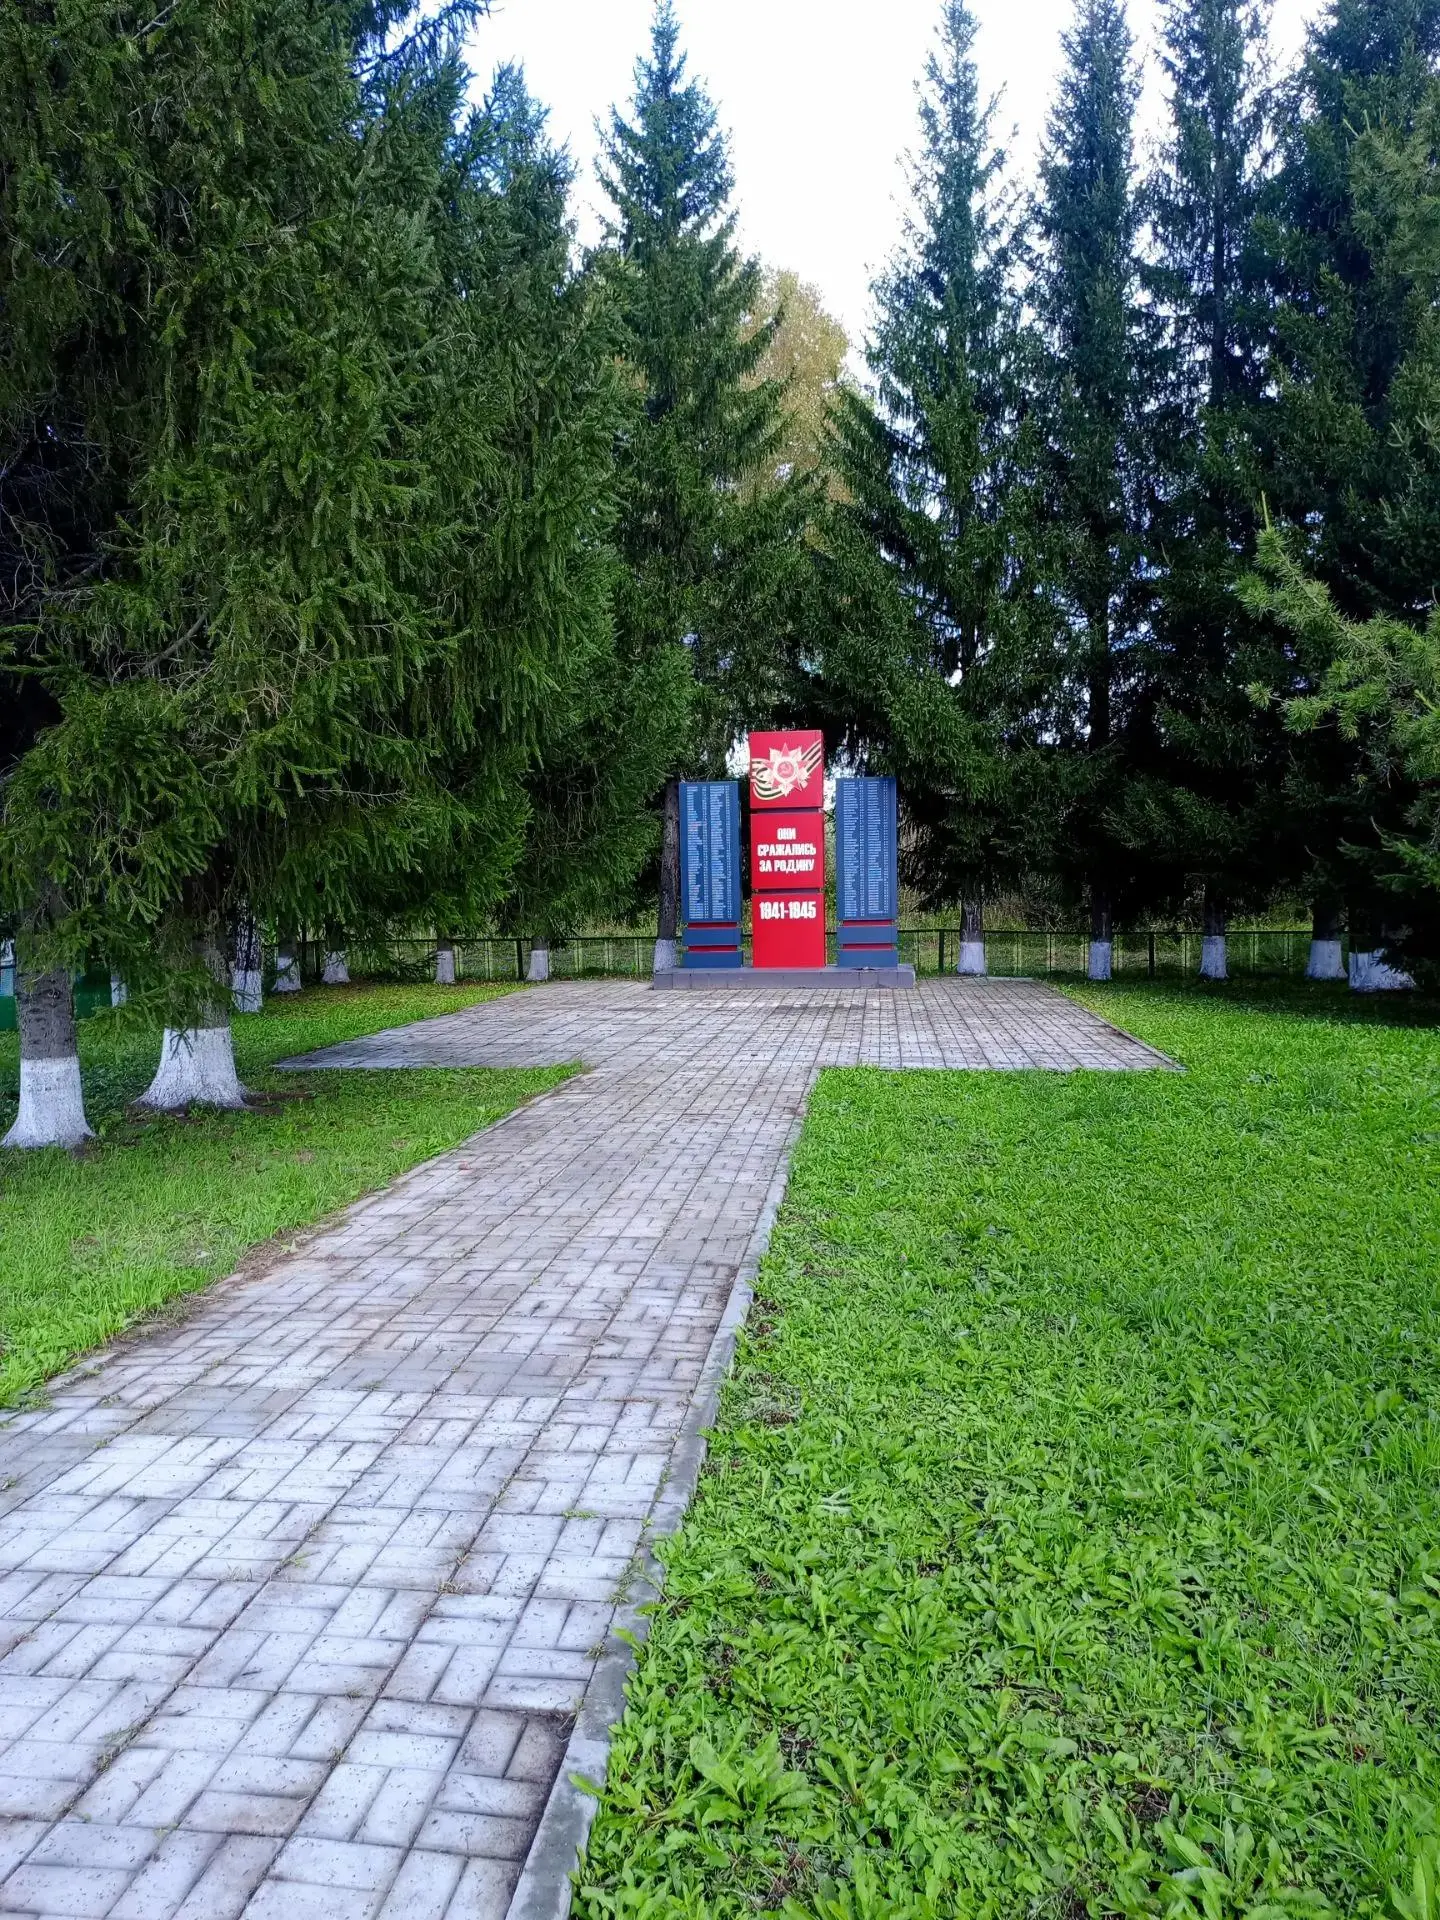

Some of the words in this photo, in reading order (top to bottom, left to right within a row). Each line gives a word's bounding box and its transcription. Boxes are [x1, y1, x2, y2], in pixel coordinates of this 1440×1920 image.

[777, 828, 796, 840] ОНИ
[757, 843, 816, 856] СРАЖАЛИСЬ
[759, 860, 772, 872] ЗА
[774, 859, 815, 873] РОДИНУ
[759, 901, 816, 919] 1941-1945
